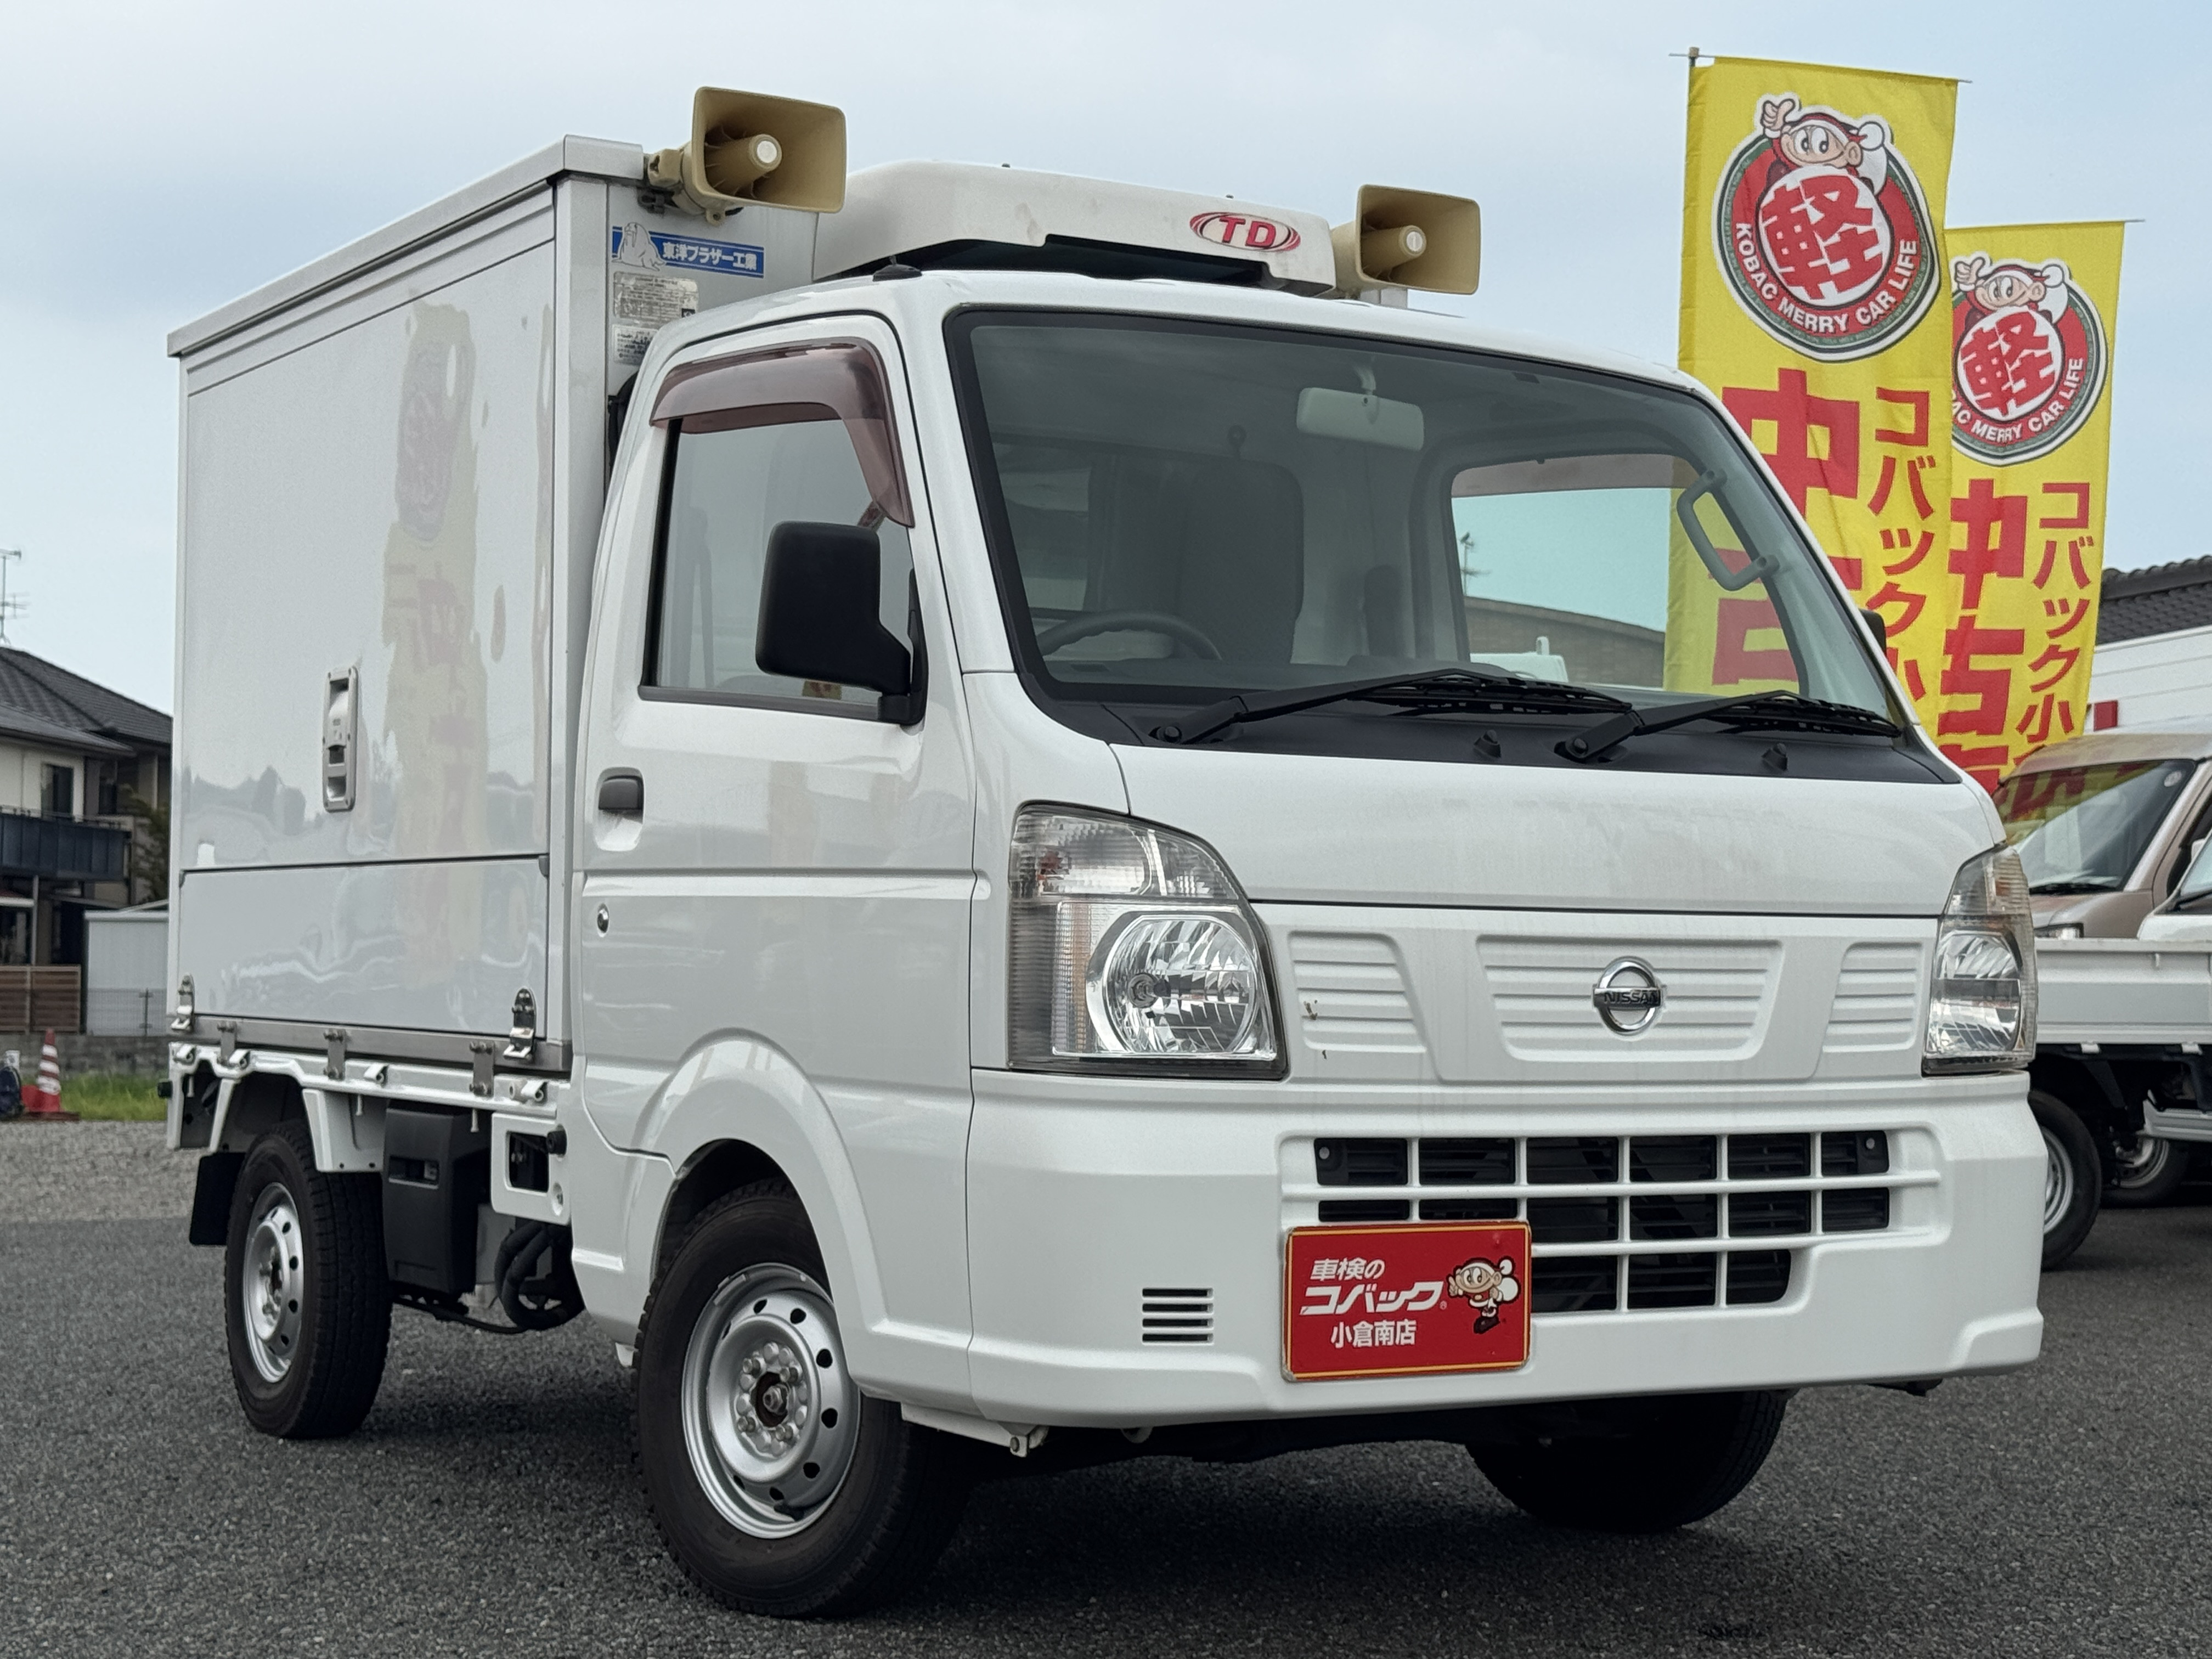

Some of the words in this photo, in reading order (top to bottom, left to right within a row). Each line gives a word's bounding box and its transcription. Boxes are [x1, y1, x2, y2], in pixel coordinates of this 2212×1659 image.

[1219, 216, 1277, 248] TD
[1736, 223, 1778, 300] KOBAC
[1778, 297, 1849, 333] MERRY
[1855, 290, 1897, 325] CAR
[1888, 239, 1917, 290] LIFE
[2028, 400, 2064, 432] CAR
[2059, 358, 2083, 400] LIFE
[1938, 478, 2028, 795] 中古
[2013, 482, 2094, 765] コバック小
[1604, 989, 1660, 1004] NISSAN
[1310, 1257, 1385, 1281] 車検の
[1299, 1280, 1444, 1316] コバック
[1330, 1319, 1417, 1348] 小倉南店
